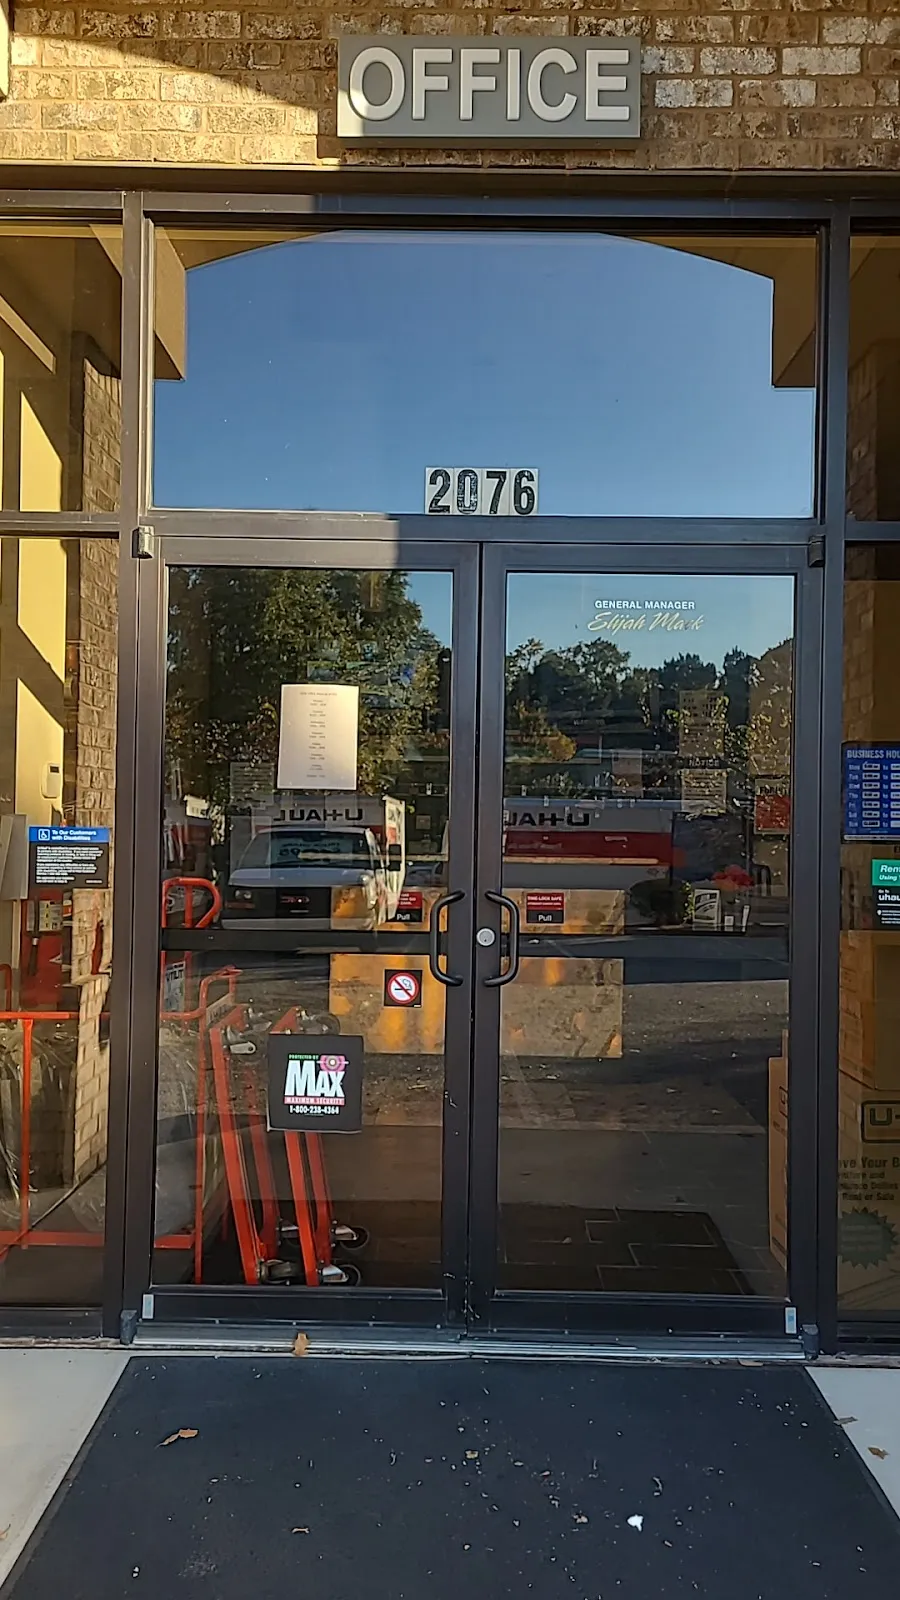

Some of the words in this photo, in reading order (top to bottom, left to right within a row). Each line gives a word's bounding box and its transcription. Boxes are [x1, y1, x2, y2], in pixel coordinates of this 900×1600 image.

[349, 46, 631, 121] OFFICE
[428, 468, 536, 515] 2076
[595, 600, 642, 609] GENERAL
[644, 601, 695, 609] MANAGER
[587, 611, 646, 636] Elijah
[847, 750, 884, 758] BUSINESS
[861, 1156, 888, 1168] Your
